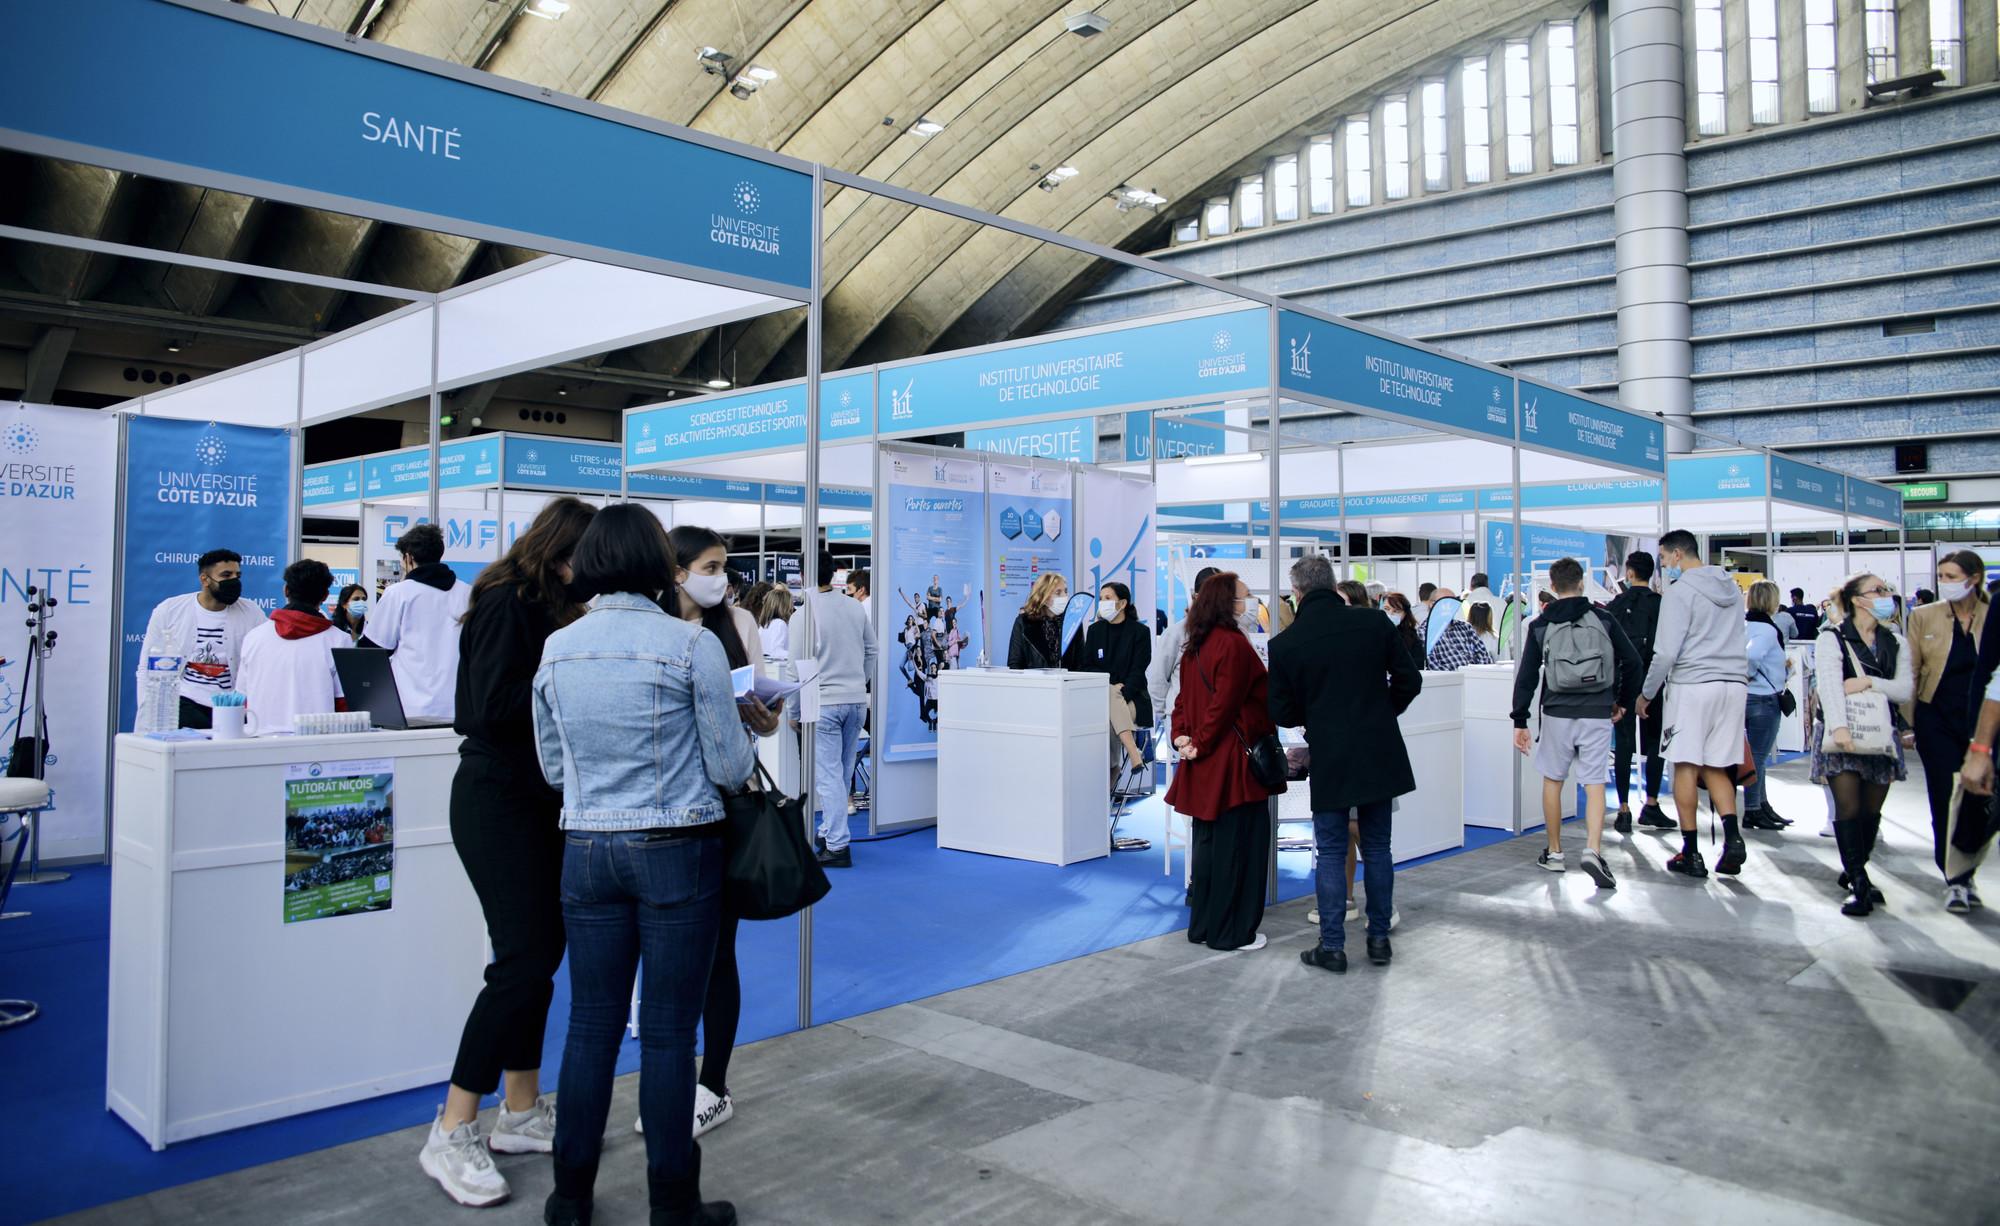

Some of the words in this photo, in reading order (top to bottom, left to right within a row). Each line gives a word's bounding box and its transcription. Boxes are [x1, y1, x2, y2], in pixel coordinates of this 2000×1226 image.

[361, 111, 462, 161] SANTÉ
[711, 213, 780, 242] UNIVERSITÉ
[710, 228, 740, 247] CÔTE
[741, 235, 780, 256] D'AZUR
[979, 365, 1031, 388] INSTITUT
[1031, 351, 1124, 380] UNIVERSITAIRE
[1198, 352, 1246, 368] UNIVERSITÉ
[1198, 366, 1218, 378] CÔTE
[1218, 363, 1246, 377] D'AZUR
[1365, 354, 1400, 378] INSTITUT
[1400, 365, 1454, 393] UNIVERSITAIRE
[999, 387, 1014, 403] DE
[1015, 374, 1101, 401] TECHNOLOGIE
[1379, 377, 1391, 394] DE
[1391, 380, 1442, 407] TECHNOLOGIE
[690, 410, 726, 427] SCIENCES
[726, 408, 736, 421] ET
[736, 400, 788, 420] TECHNIQUES
[664, 434, 679, 447] DES
[716, 422, 760, 441] PHYSIQUES
[760, 420, 772, 433] ET
[771, 415, 807, 431] SPORTIV
[1568, 411, 1590, 430] INSTITUT
[1590, 419, 1624, 438] UNIVERSITAIRE
[1577, 428, 1585, 442] DE
[1585, 430, 1617, 450] TECHNOLOGIE
[570, 454, 600, 464] LETTRES
[604, 459, 622, 467] LANG
[159, 471, 257, 492] UNIVERSITÉ
[578, 466, 610, 476] SCIENCES
[611, 470, 621, 478] DE
[11, 482, 75, 500] D'AZUR
[157, 487, 199, 504] CÔTE
[203, 490, 257, 508] D'AZUR
[1910, 487, 1938, 497] SECOURS
[906, 497, 930, 512] Portes
[933, 498, 962, 510] ouvertes
[1300, 499, 1336, 510] GRADUATE
[1336, 497, 1365, 509] SHOOL
[1365, 496, 1375, 506] OF
[1375, 494, 1430, 506] MANAGEMENT
[155, 552, 201, 564] CHIRUR
[290, 781, 338, 795] TUTORAT
[338, 779, 373, 793] NIÇOIS
[696, 1098, 728, 1127] BADASS
